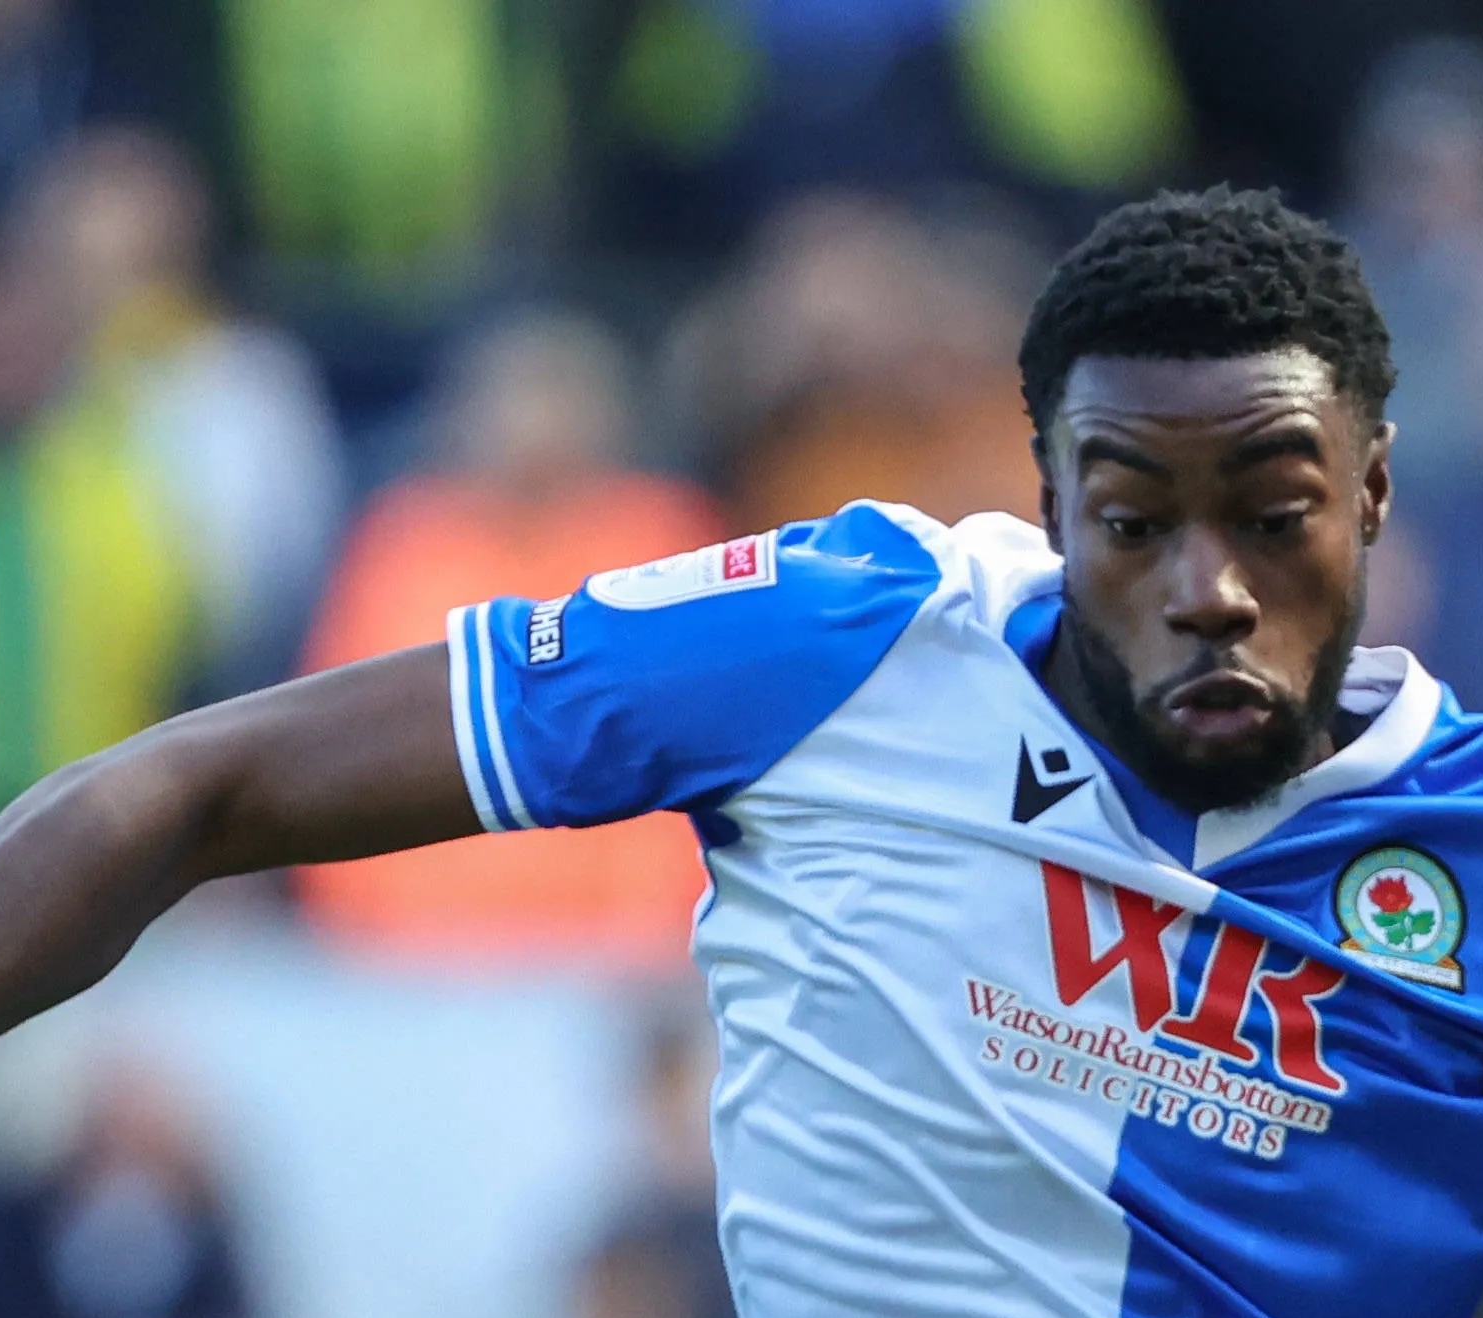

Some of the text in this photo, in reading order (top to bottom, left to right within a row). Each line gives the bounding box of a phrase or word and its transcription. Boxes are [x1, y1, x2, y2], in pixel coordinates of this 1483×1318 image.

[1041, 860, 1346, 1096] WR
[965, 979, 1329, 1129] WatsonRamsbottom
[983, 1037, 1284, 1156] SOLICITORS
